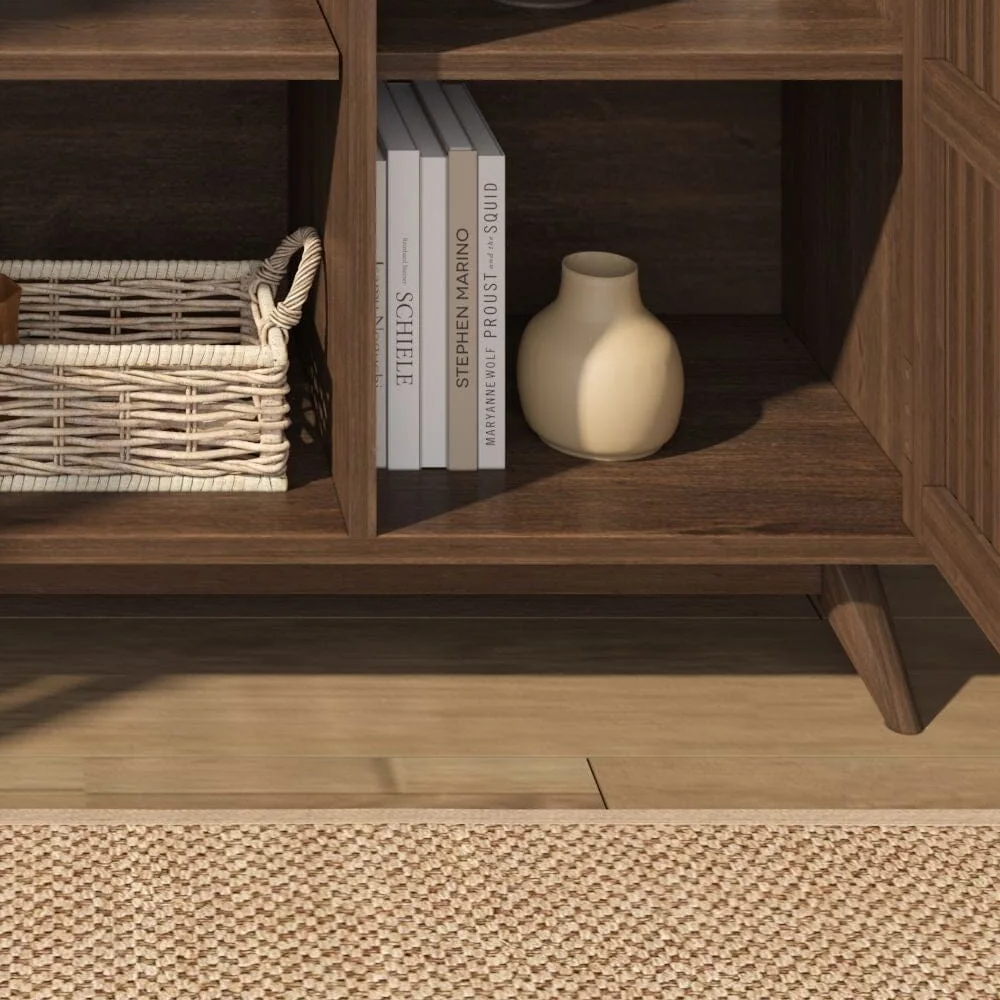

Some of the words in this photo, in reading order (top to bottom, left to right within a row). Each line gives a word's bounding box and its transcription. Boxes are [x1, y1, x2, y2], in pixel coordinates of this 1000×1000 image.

[483, 182, 499, 234] SQUID
[455, 228, 469, 300] MARINO
[483, 272, 498, 338] PROUST
[395, 292, 414, 386] SCHIELE
[455, 306, 469, 389] STEPHEN
[485, 347, 497, 379] WOLF
[485, 382, 497, 446] MARYANNE
